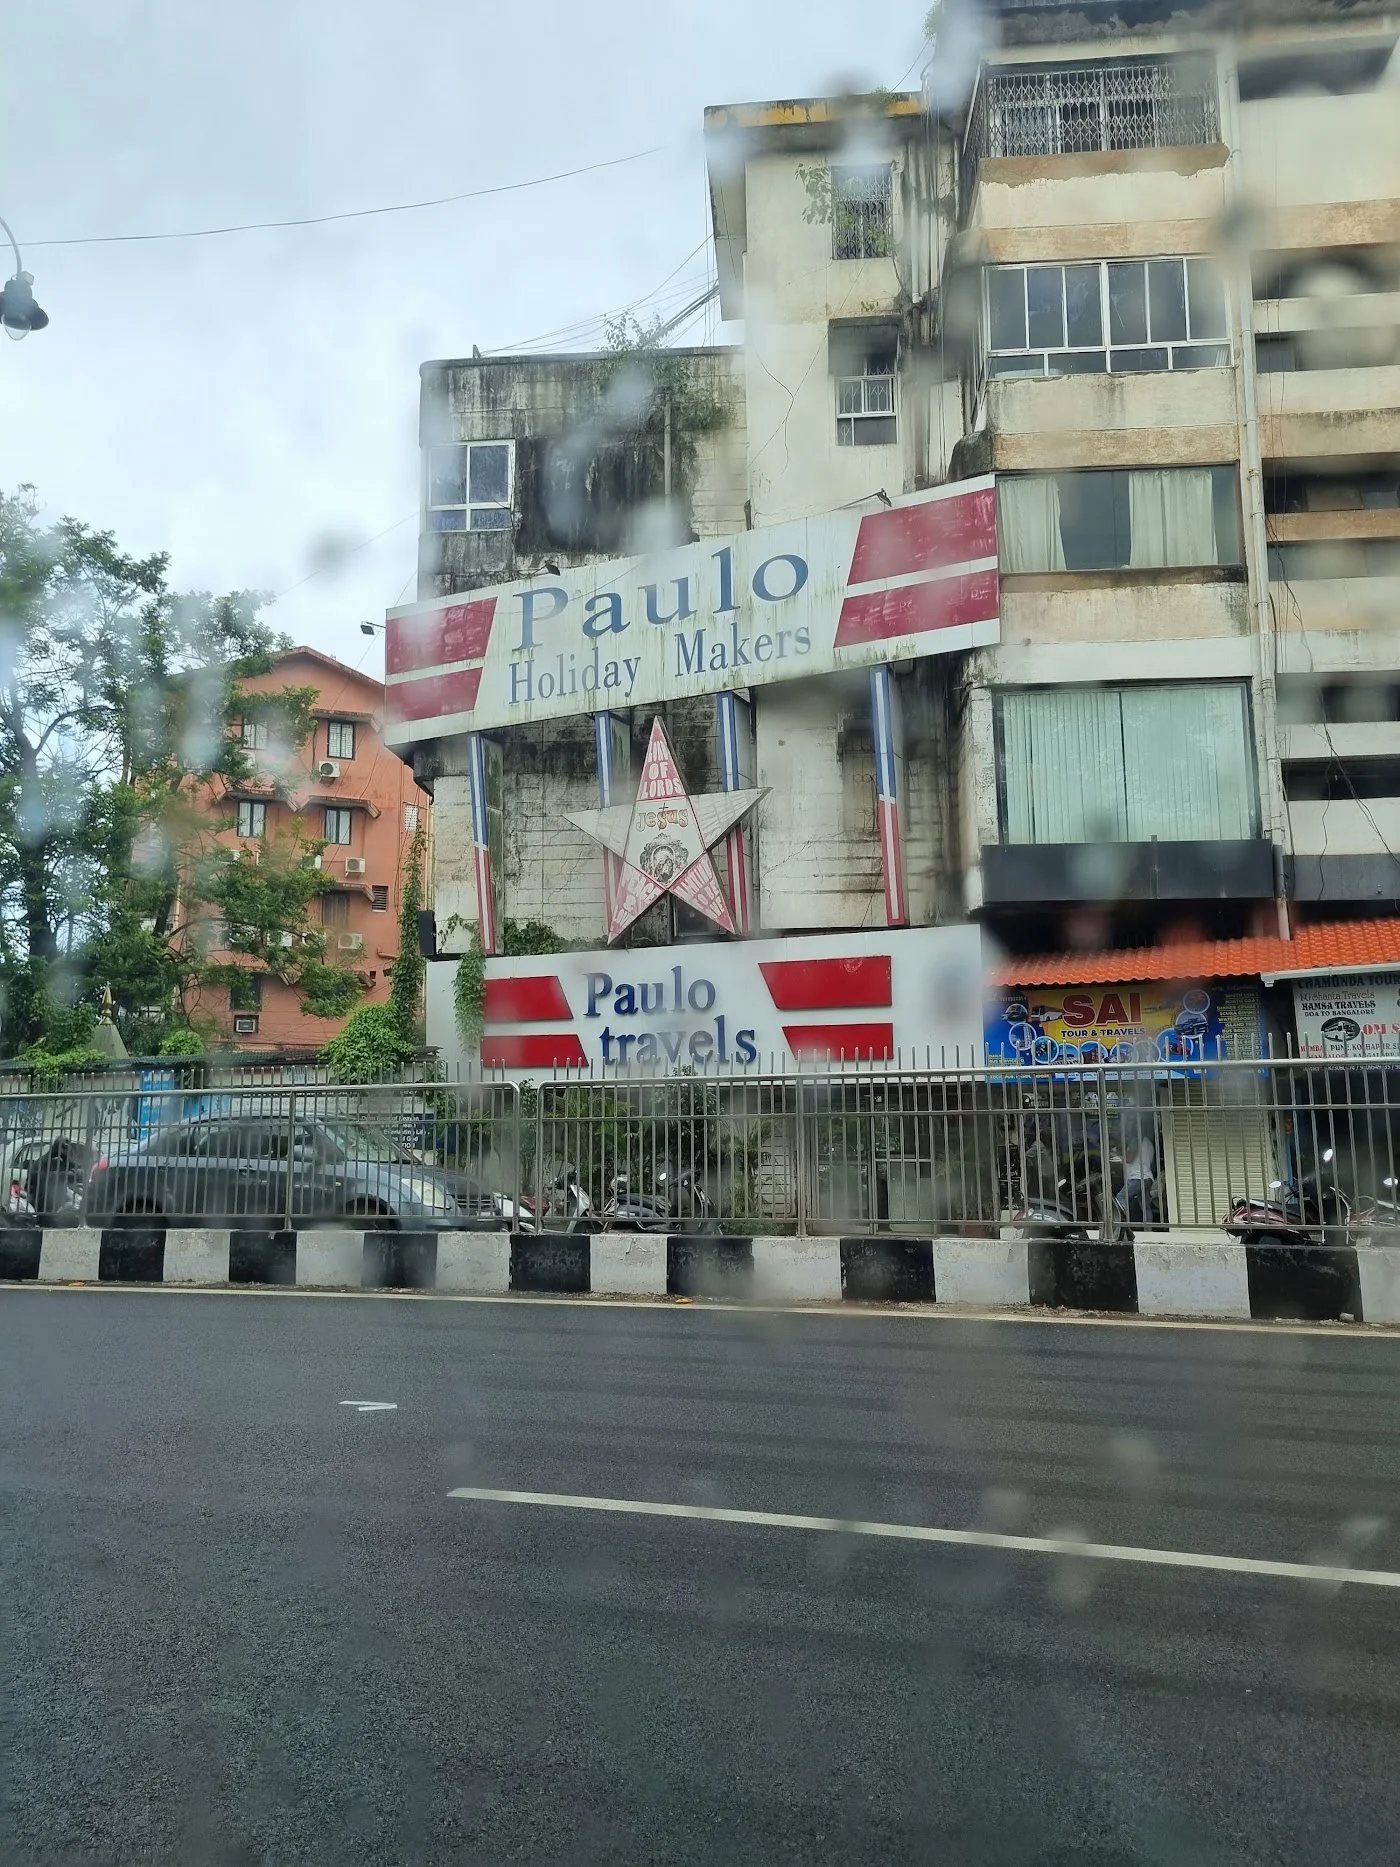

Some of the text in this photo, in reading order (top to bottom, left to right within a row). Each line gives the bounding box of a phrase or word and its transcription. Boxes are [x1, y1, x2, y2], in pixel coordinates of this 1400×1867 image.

[512, 546, 809, 652] Paulo
[509, 622, 812, 705] Holiday Makers
[648, 761, 669, 780] OF
[640, 777, 682, 800] LORDS
[583, 966, 716, 1017] Paulo
[1298, 975, 1365, 989] CHAMUNDA
[1342, 989, 1376, 1000] Travels
[1062, 991, 1143, 1028] SAI
[1302, 1000, 1376, 1011] HAMSA TRAVELS
[1332, 1009, 1375, 1017] BANGALORE
[1061, 1028, 1145, 1038] TOUR & TRAVELS
[1362, 1023, 1387, 1035] OM
[599, 1015, 757, 1066] travels
